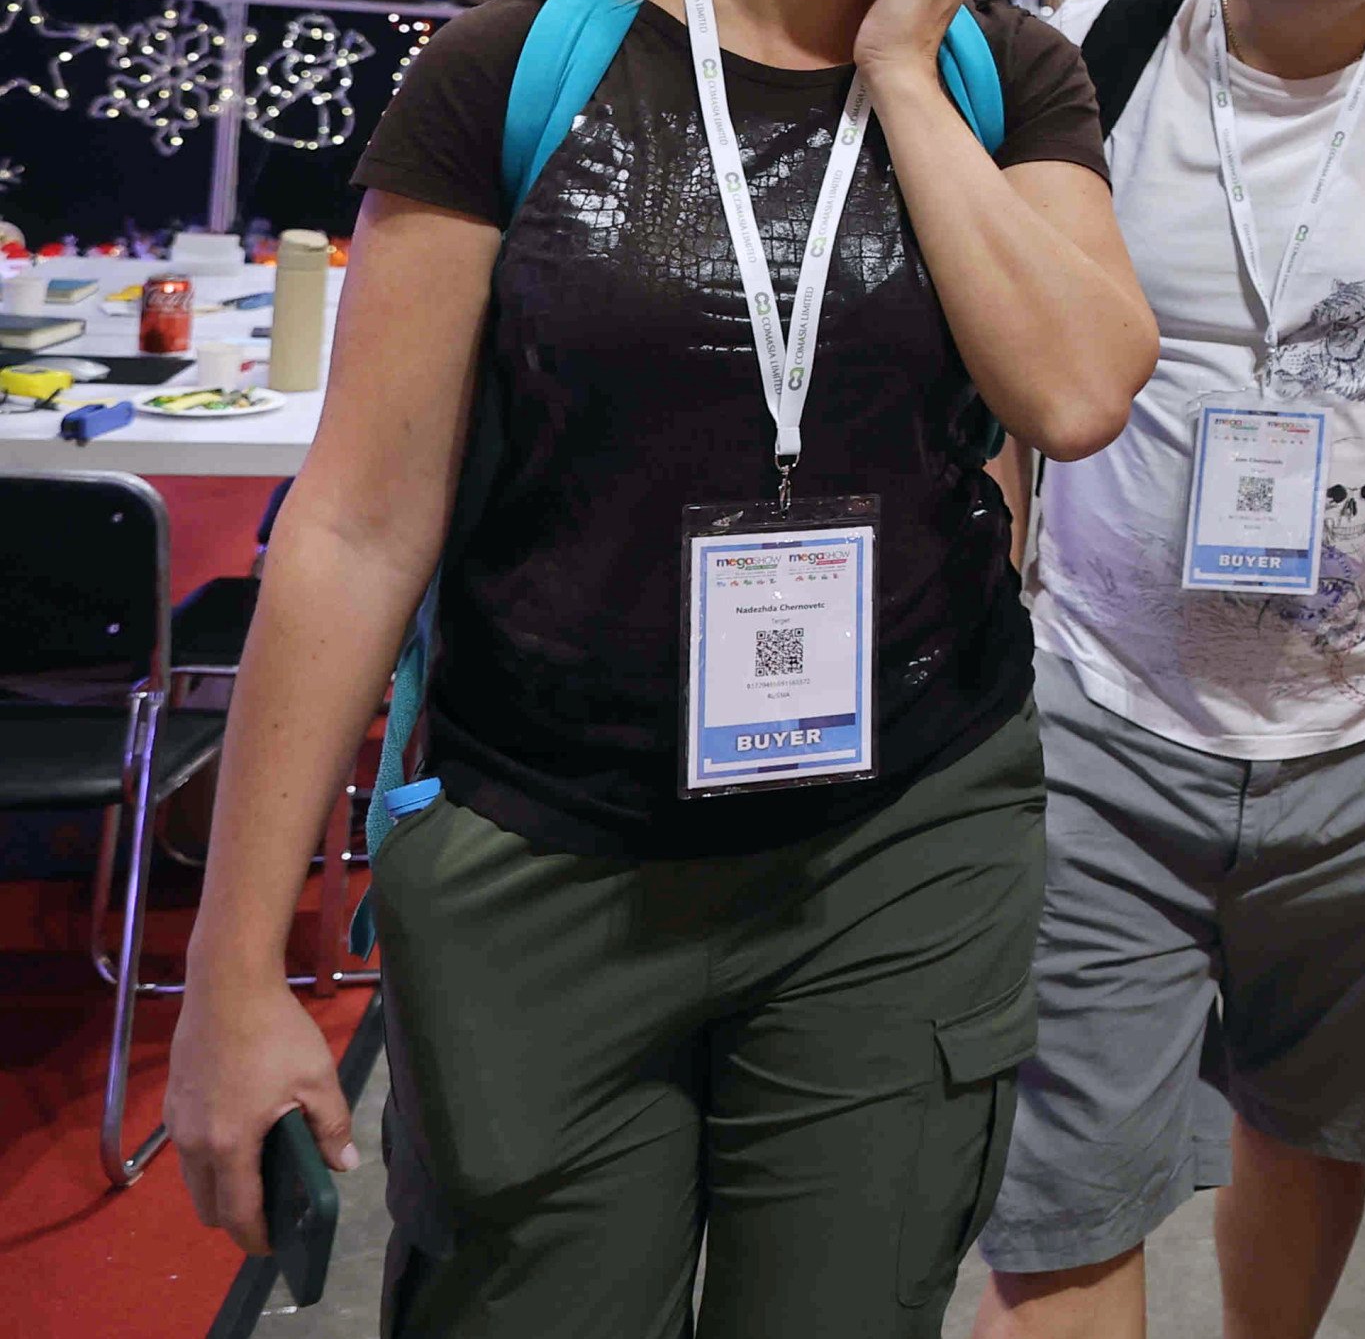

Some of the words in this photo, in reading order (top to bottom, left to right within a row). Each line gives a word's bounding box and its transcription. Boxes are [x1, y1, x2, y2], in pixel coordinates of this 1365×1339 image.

[801, 286, 814, 325] LIMITED
[761, 316, 777, 360] COMASIA
[769, 358, 783, 395] LIMITED
[794, 323, 809, 365] COMASIA
[1218, 554, 1282, 570] BUYER
[735, 605, 778, 614] Nadezhda
[736, 728, 822, 752] BUYER
